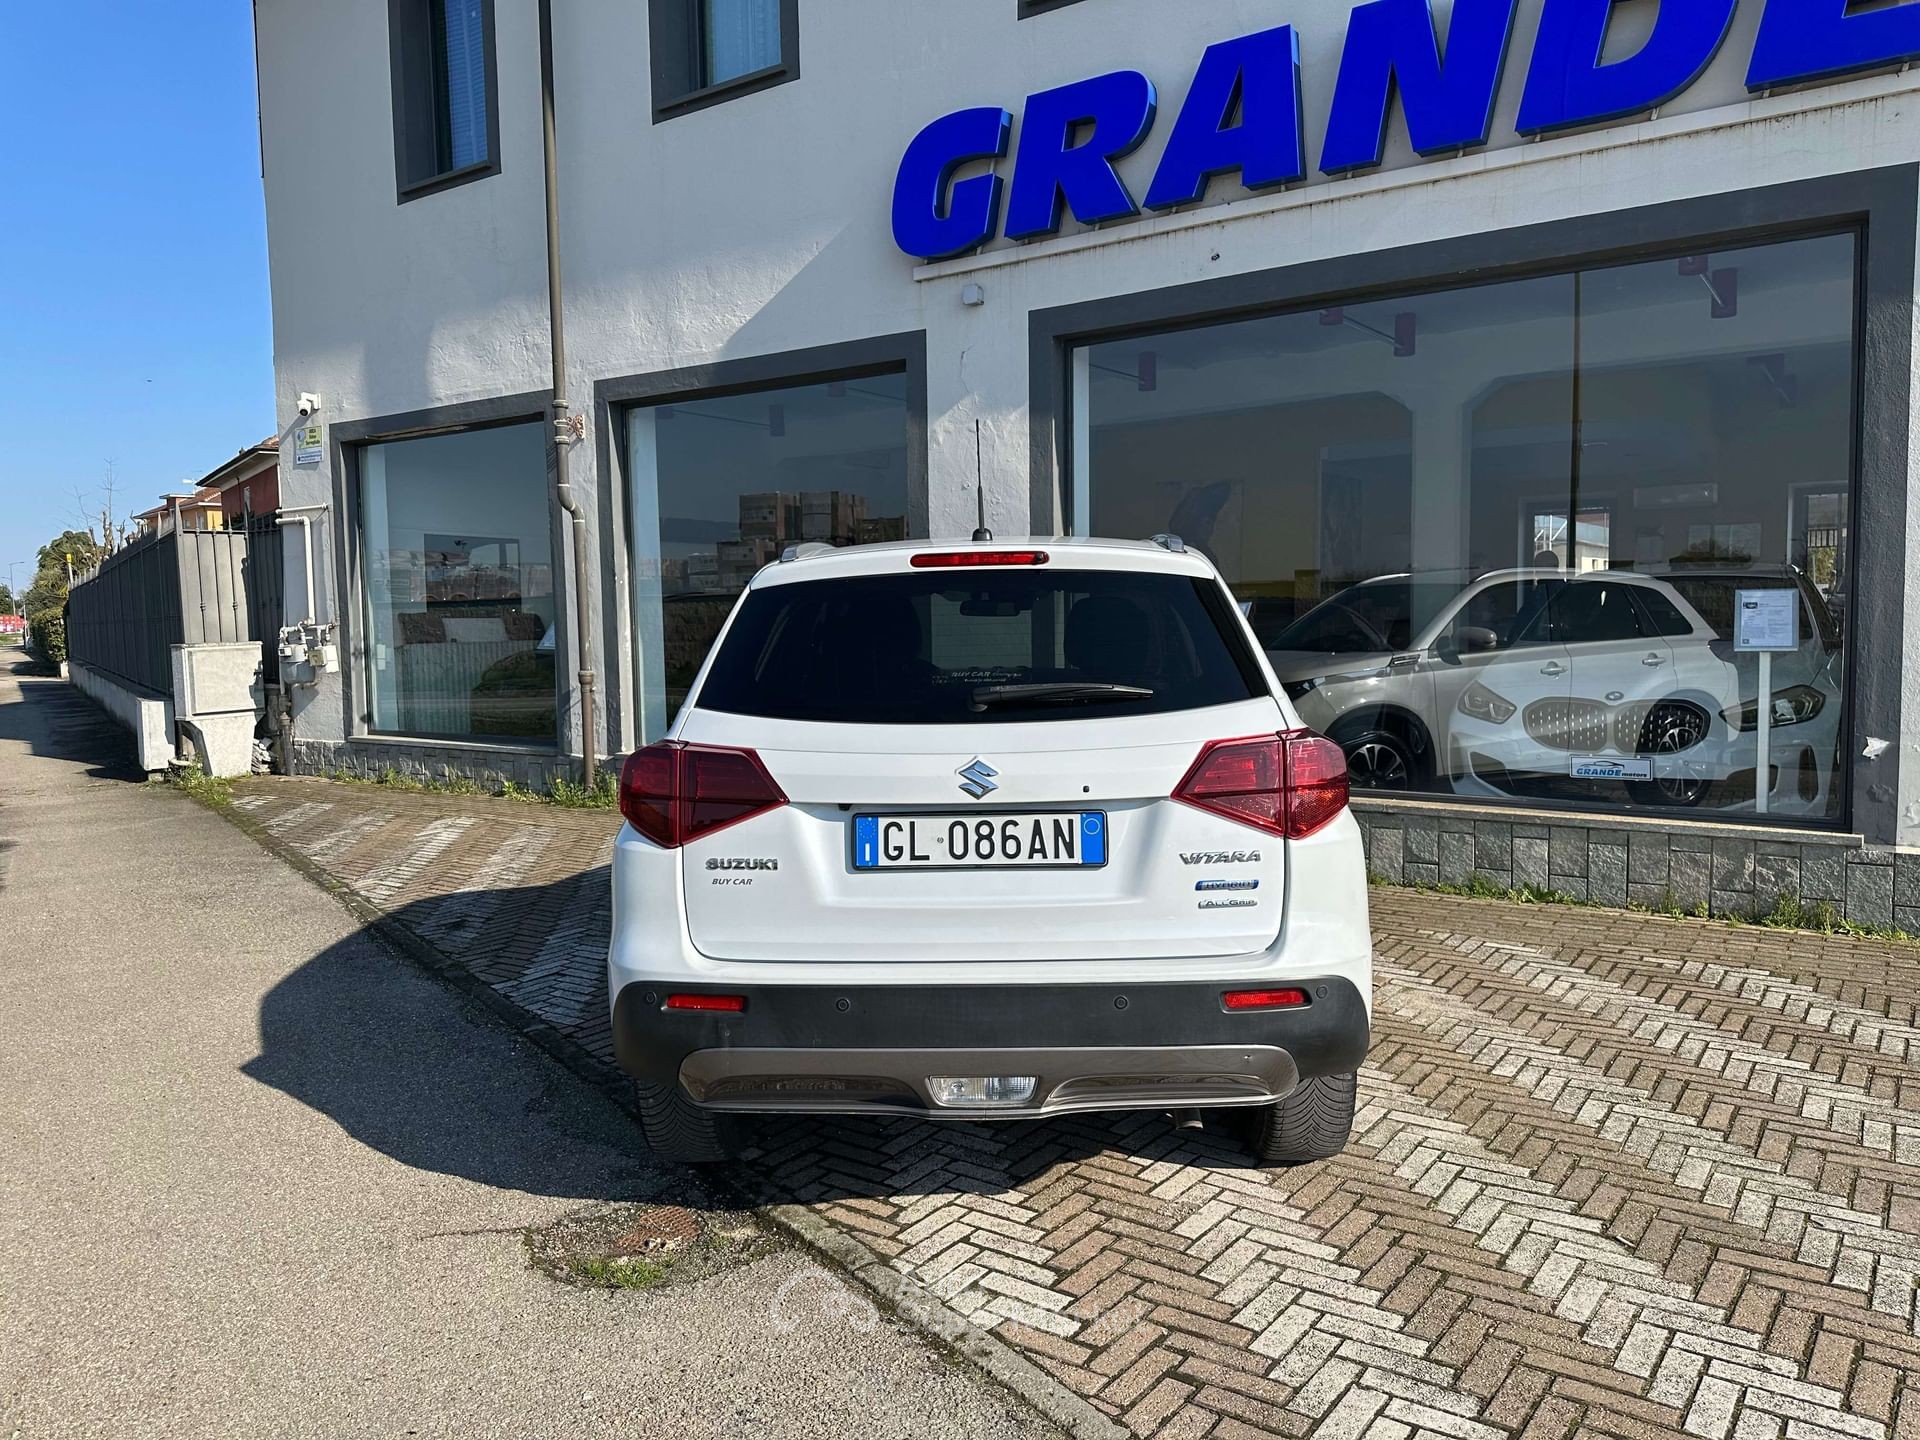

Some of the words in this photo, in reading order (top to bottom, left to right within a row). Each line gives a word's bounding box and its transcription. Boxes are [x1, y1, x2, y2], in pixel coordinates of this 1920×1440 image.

[1576, 767, 1622, 777] GRANDE
[883, 820, 930, 861] GL
[948, 818, 1075, 861] 086AN
[1178, 850, 1261, 865] VITARA
[705, 857, 778, 871] SUZUKI
[711, 878, 732, 886] BUY
[732, 878, 753, 886] CAR
[1205, 880, 1253, 889] HYBRID
